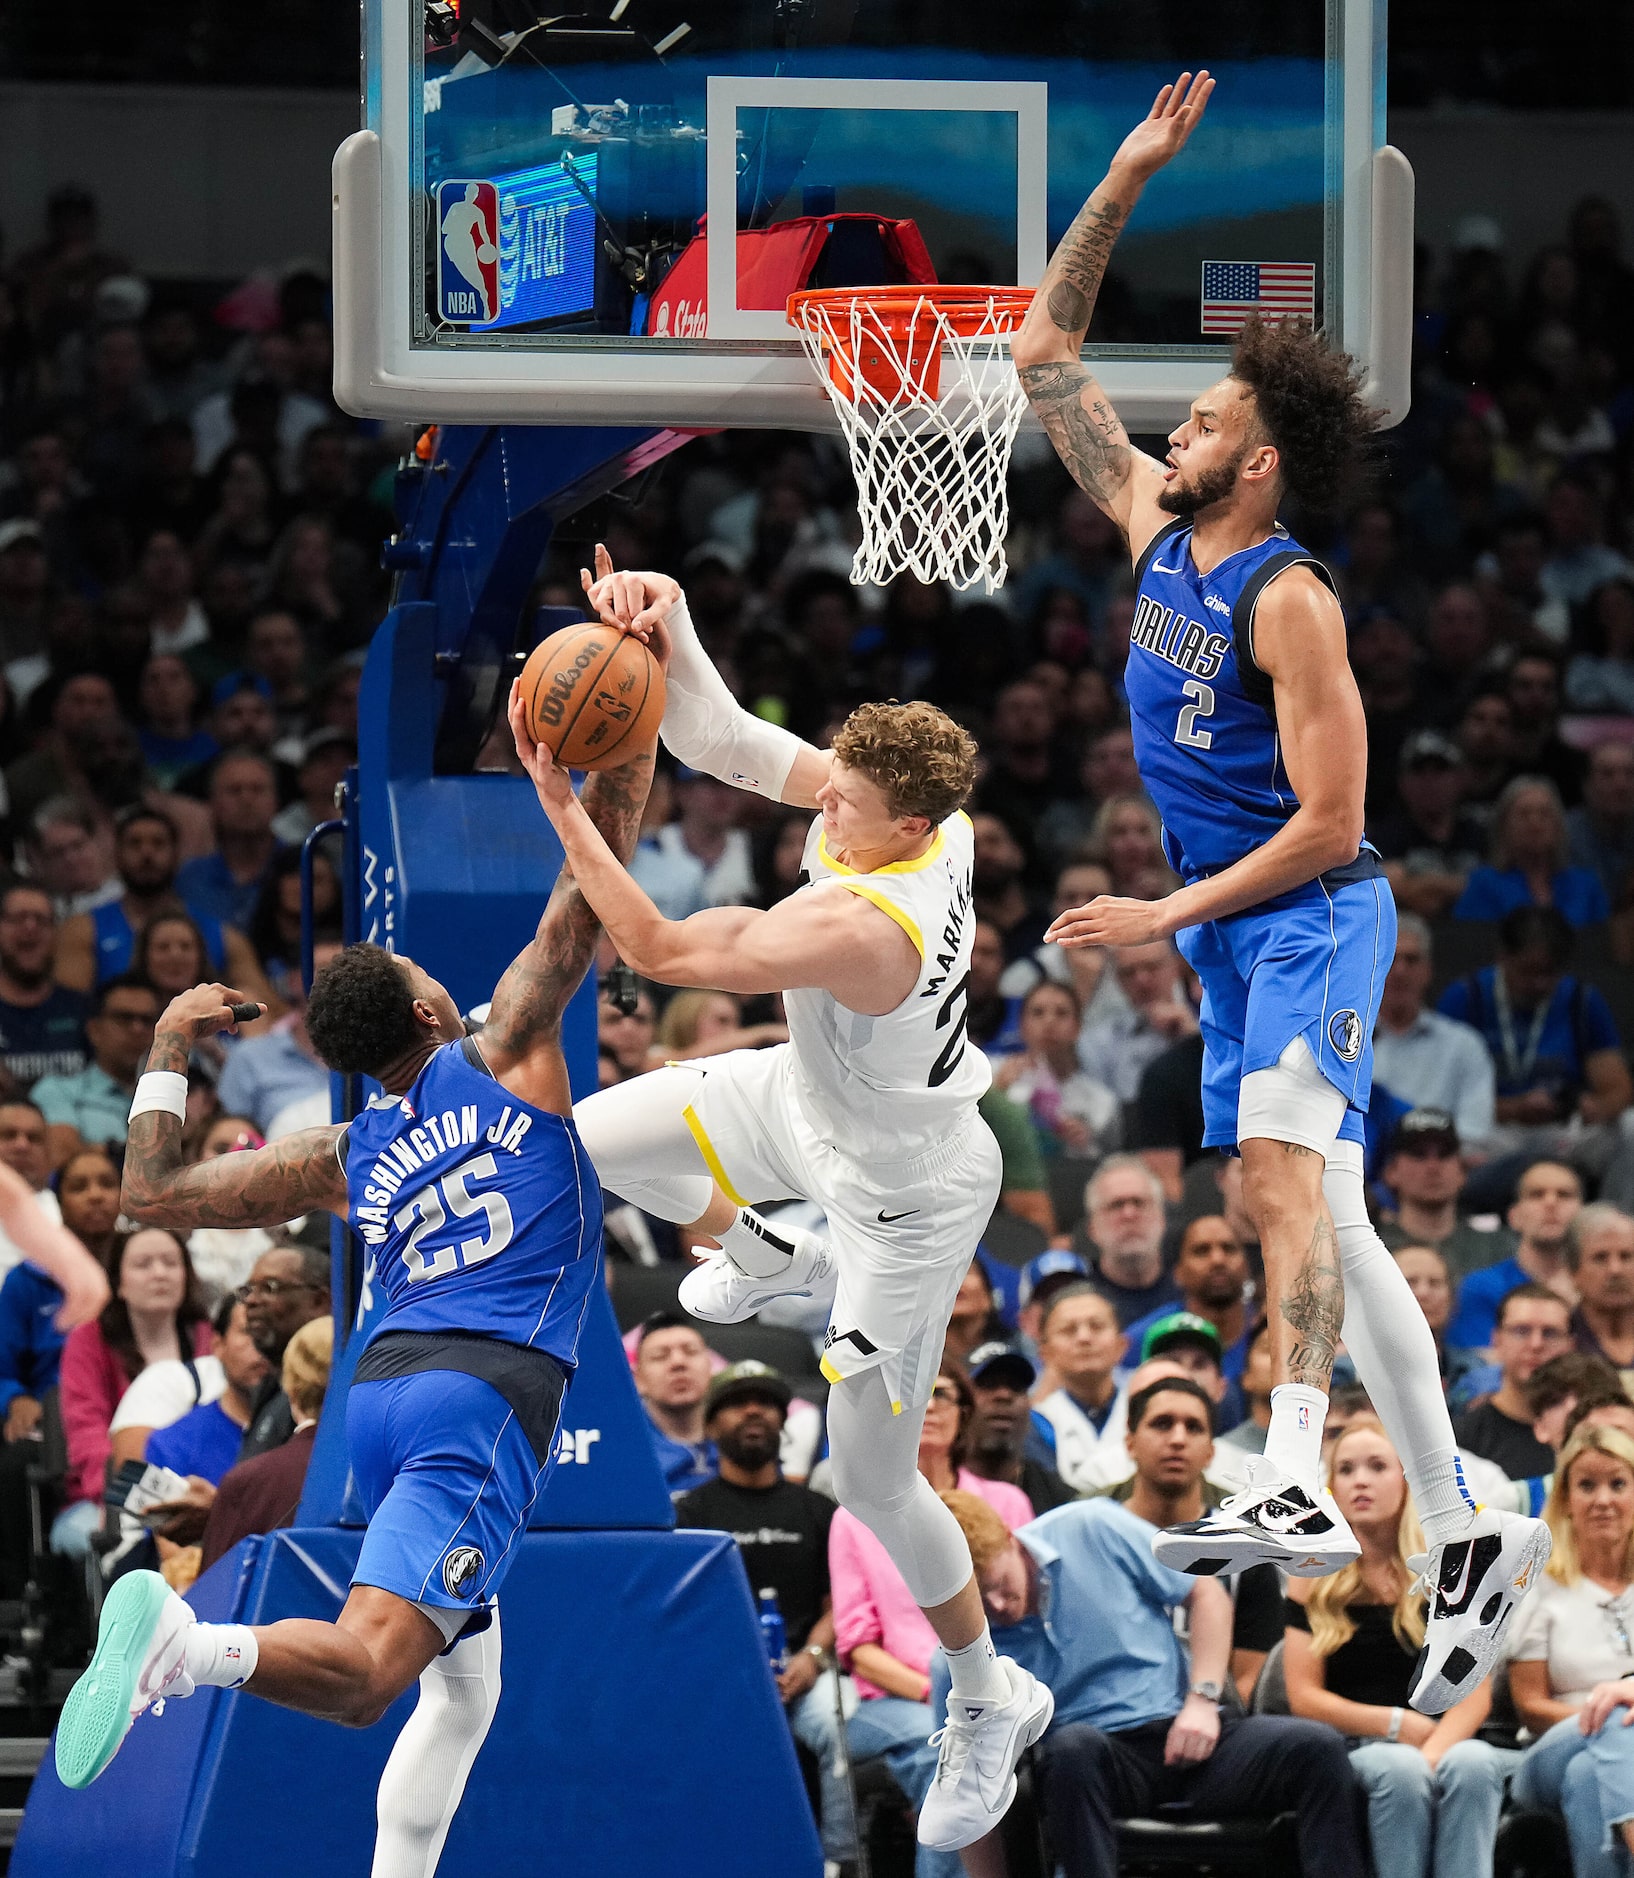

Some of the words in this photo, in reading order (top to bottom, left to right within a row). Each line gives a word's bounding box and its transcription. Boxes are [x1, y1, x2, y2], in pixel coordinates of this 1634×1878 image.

[522, 201, 570, 281] AT&T
[447, 291, 477, 315] NBA
[1130, 594, 1230, 681] DALLAS
[1203, 593, 1231, 617] chime
[539, 641, 605, 727] Wilson
[1173, 679, 1215, 750] 2
[356, 1104, 478, 1245] WASHINGTON
[486, 1105, 533, 1157] JR.
[393, 1152, 514, 1284] 25
